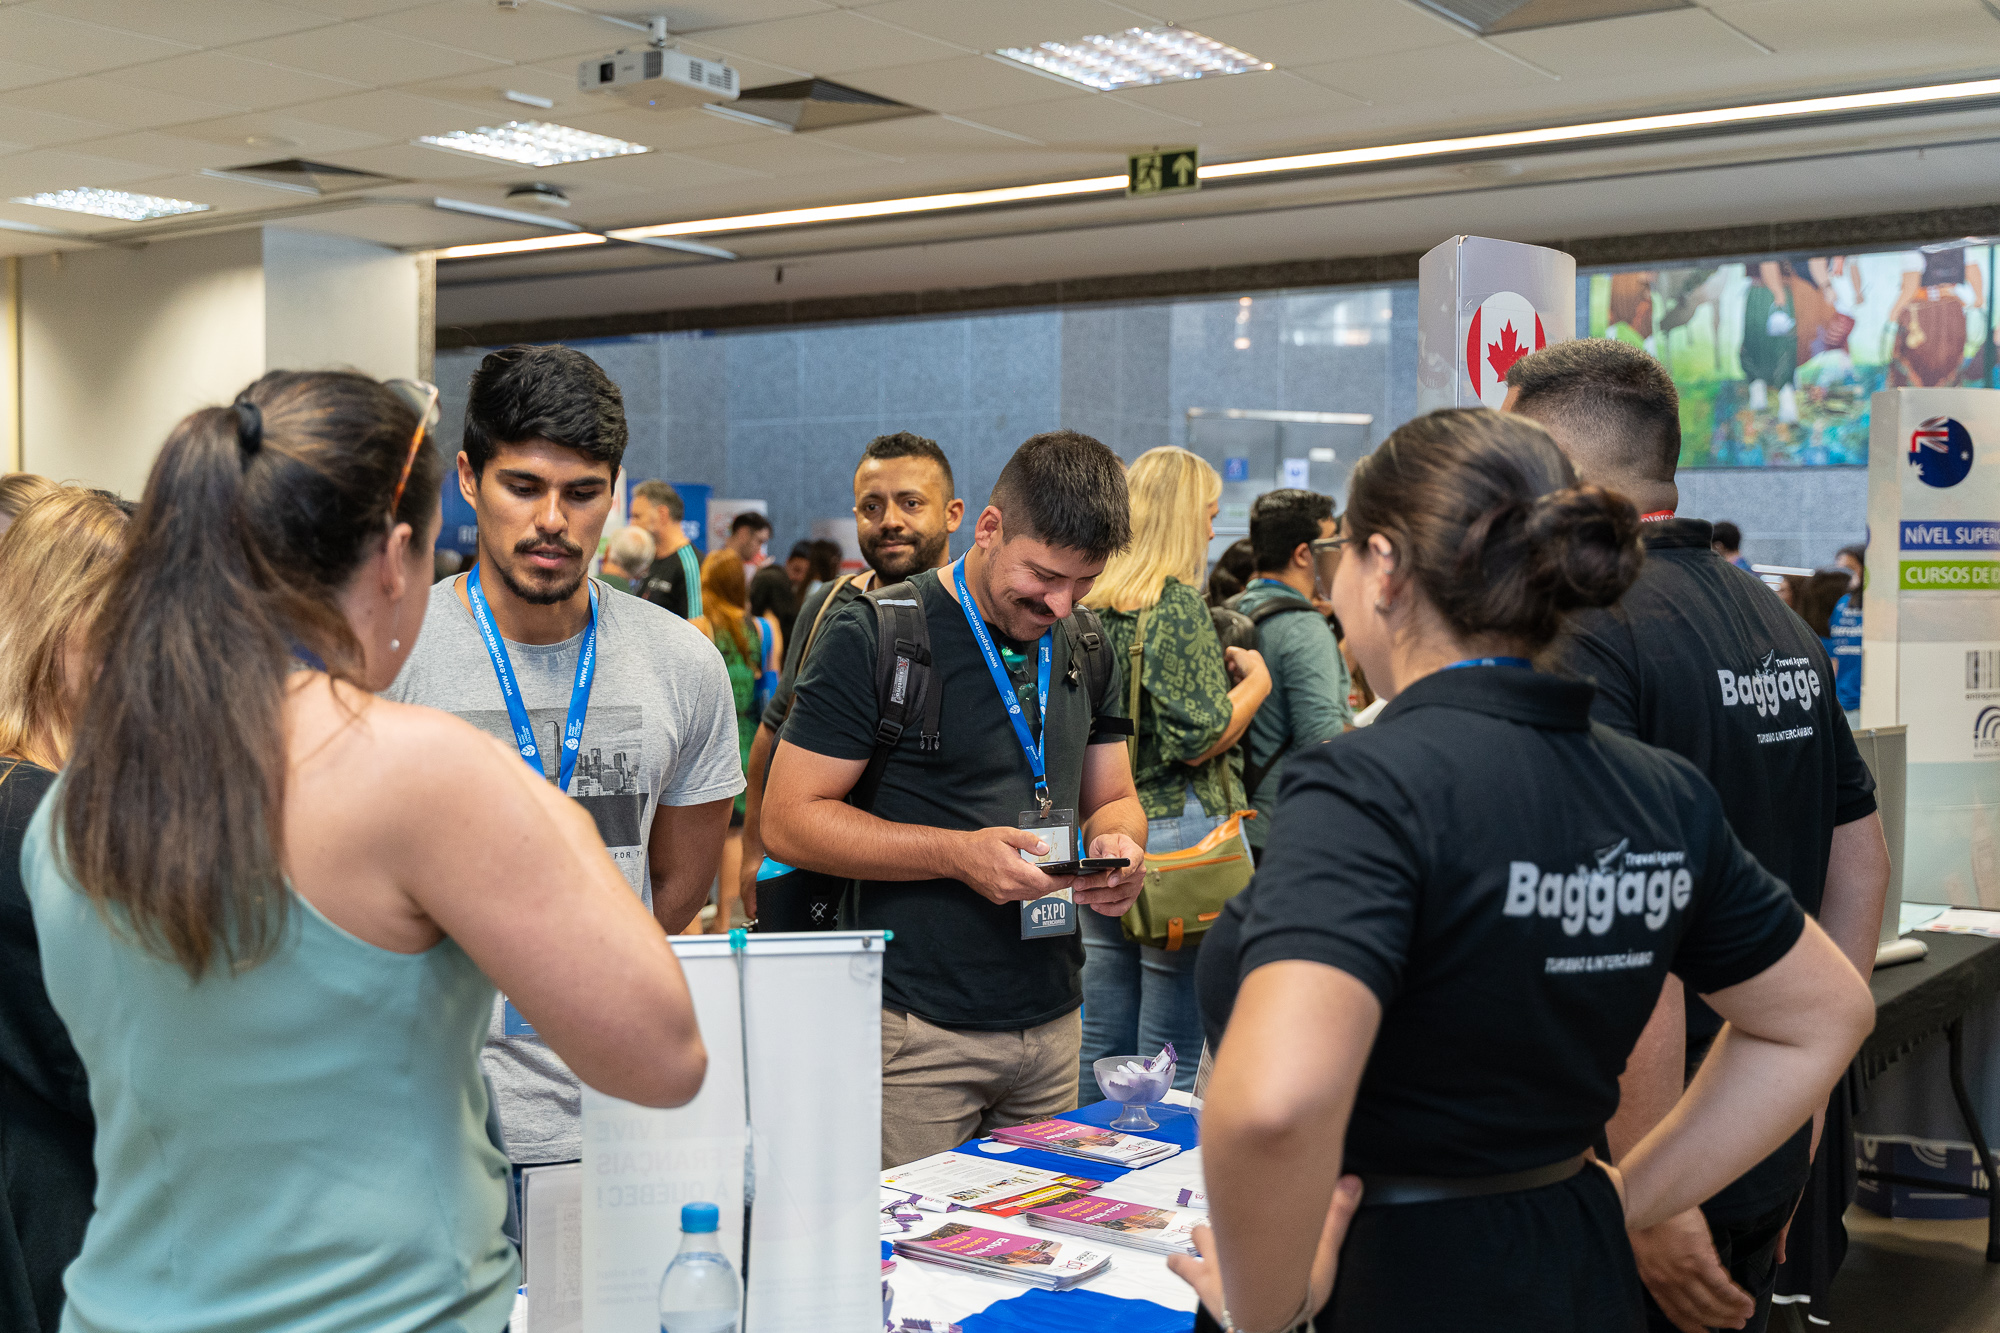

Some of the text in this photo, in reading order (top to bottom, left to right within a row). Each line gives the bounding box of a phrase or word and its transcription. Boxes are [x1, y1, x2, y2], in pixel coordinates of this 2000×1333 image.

[1904, 524, 1952, 545] NÍVEL
[1905, 566, 1970, 584] CURSOS
[1972, 566, 1990, 584] DE
[470, 585, 513, 697] www.expointercambio.com
[958, 580, 998, 669] www.expointercambio.com
[1717, 669, 1820, 717] Baggage
[1042, 902, 1065, 920] EXPO
[1502, 860, 1693, 937] Baggage
